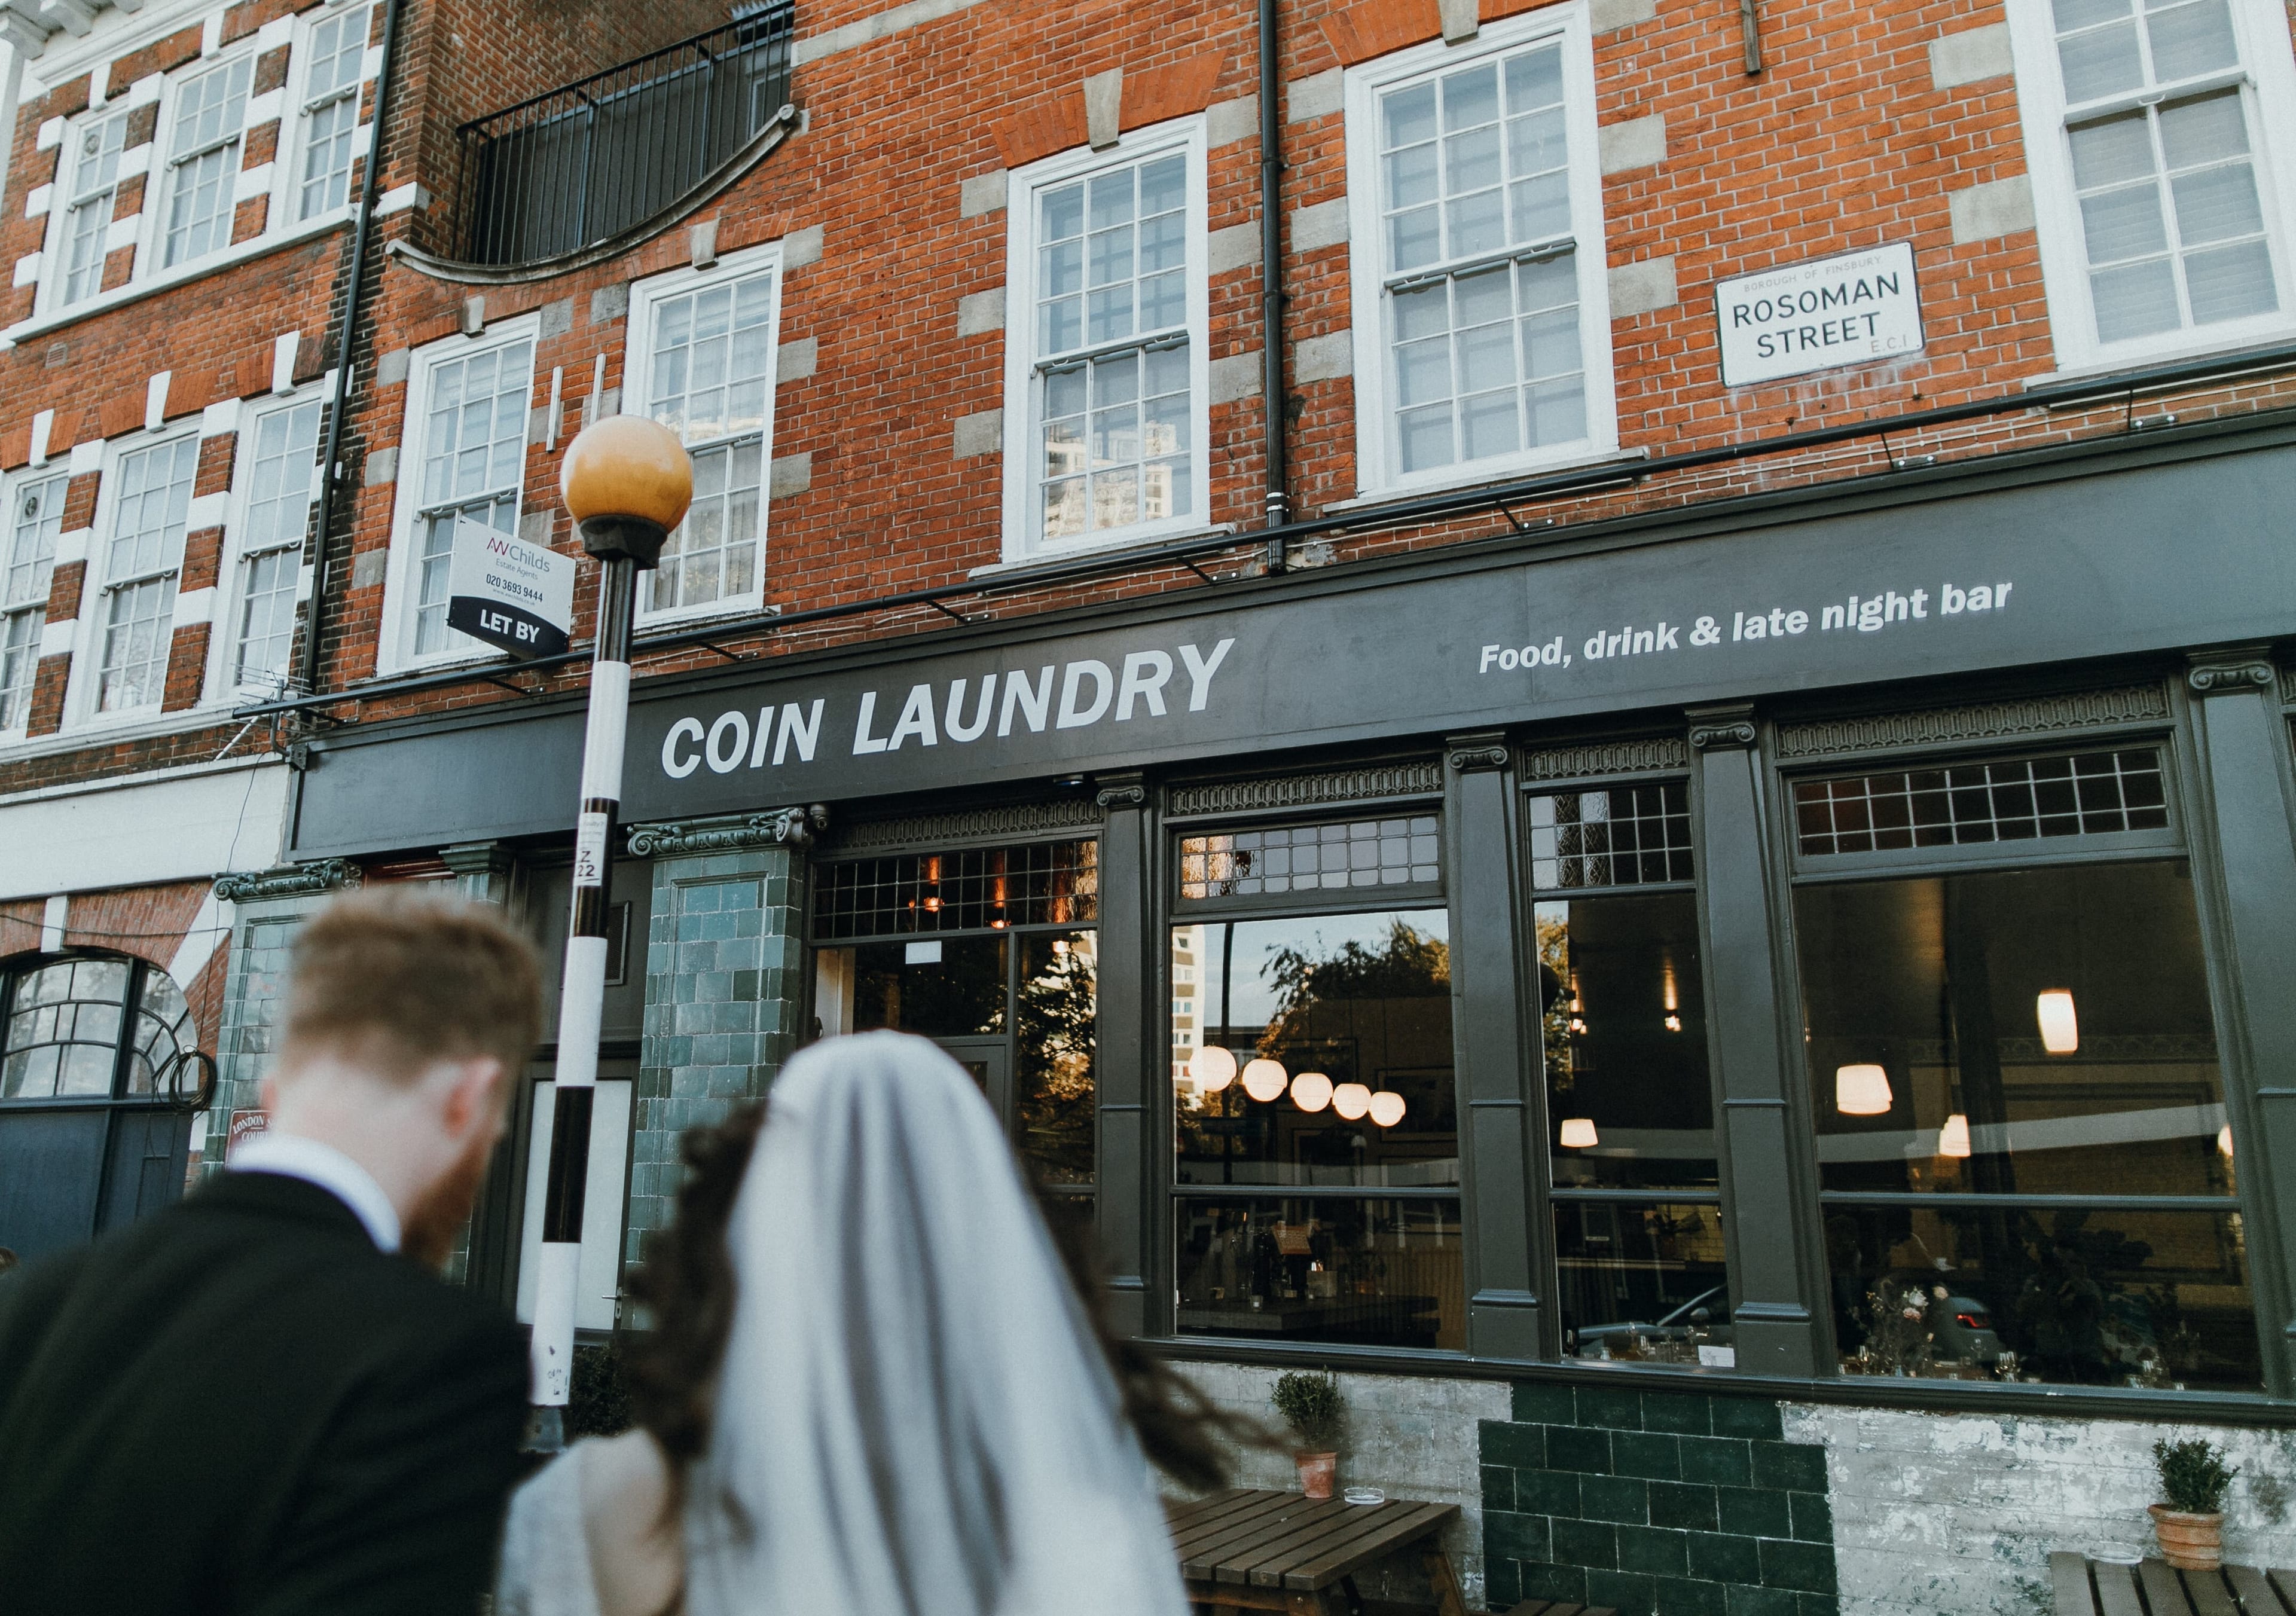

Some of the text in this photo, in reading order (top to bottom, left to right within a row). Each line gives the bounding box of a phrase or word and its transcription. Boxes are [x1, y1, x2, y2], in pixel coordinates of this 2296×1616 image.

[1744, 256, 1882, 292] BOROUGH OF FINSBURY
[1733, 271, 1900, 328] ROSOMAN
[1757, 311, 1880, 358] STREET
[496, 558, 538, 580] Estate Agents
[486, 573, 543, 603] 020 3693 9444
[480, 609, 540, 643] LET BY
[1479, 582, 2013, 673] Food, drink & late night bar
[661, 638, 1236, 779] COIN LAUNDRY
[233, 1115, 264, 1135] LONDON
